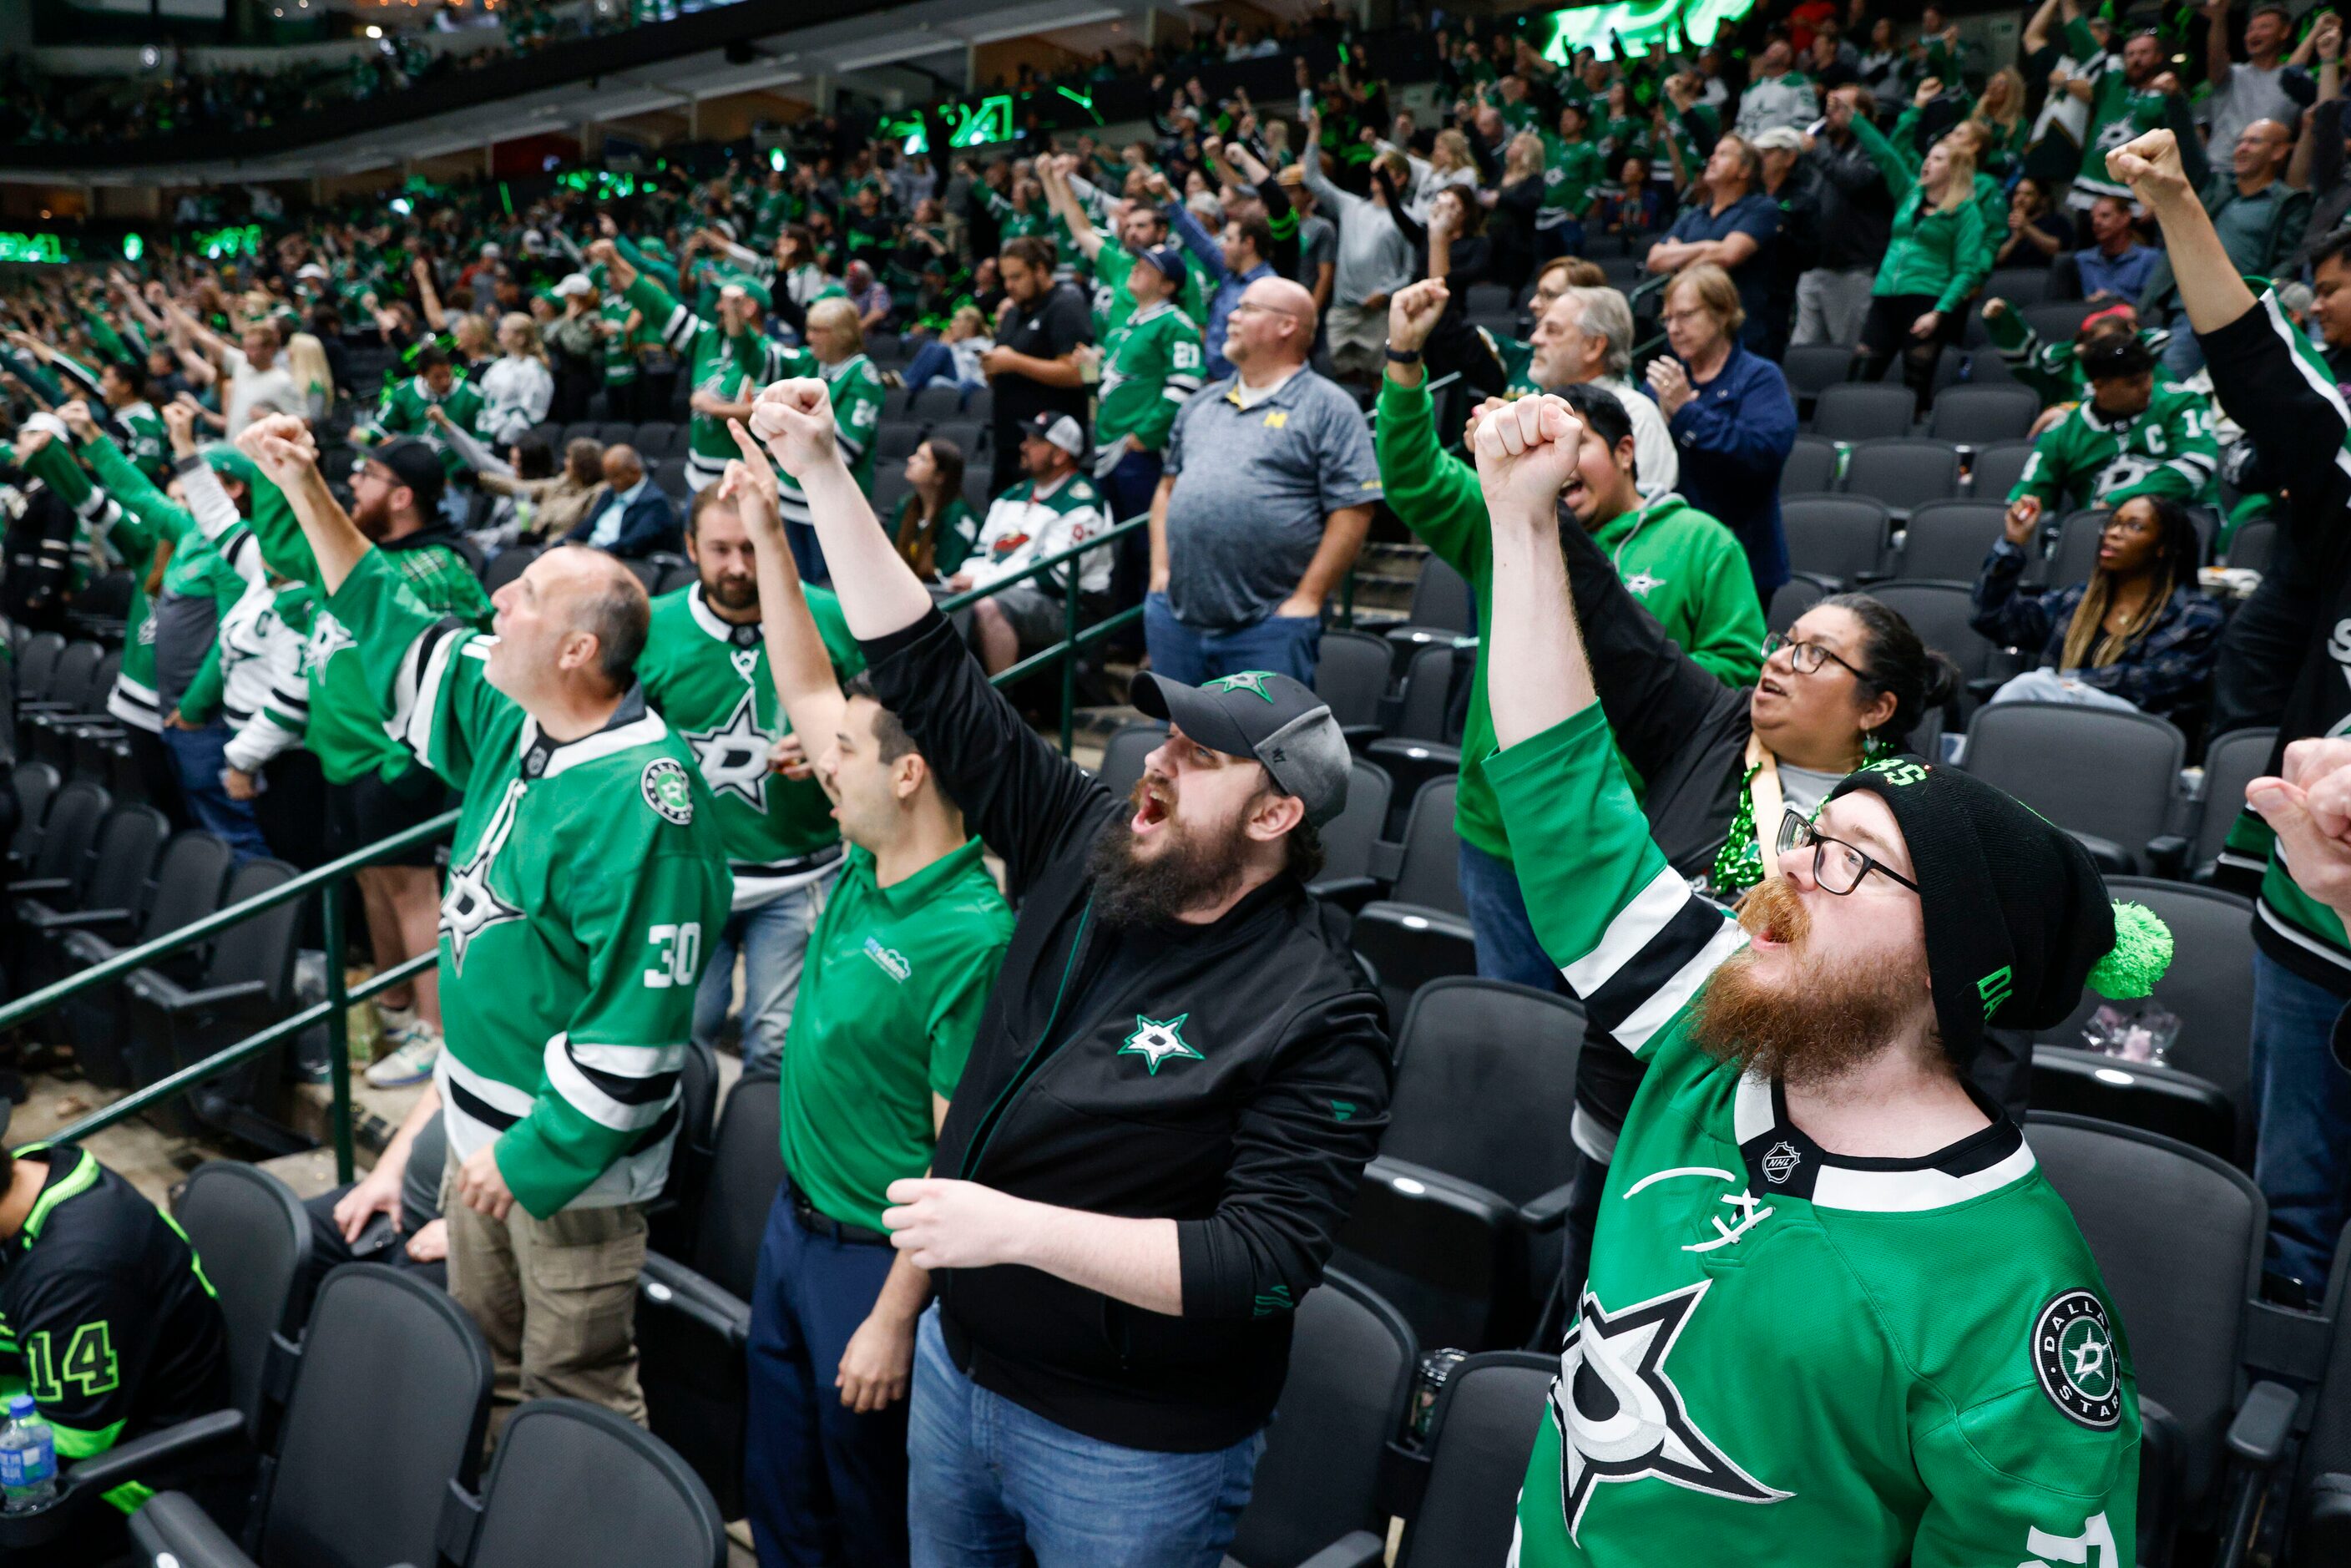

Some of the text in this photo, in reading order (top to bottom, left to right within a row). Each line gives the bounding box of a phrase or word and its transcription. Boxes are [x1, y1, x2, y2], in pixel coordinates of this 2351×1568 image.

[2145, 423, 2168, 455] C
[644, 921, 701, 988] 30
[1767, 1158, 1790, 1167] NHL
[26, 1319, 119, 1402] 14
